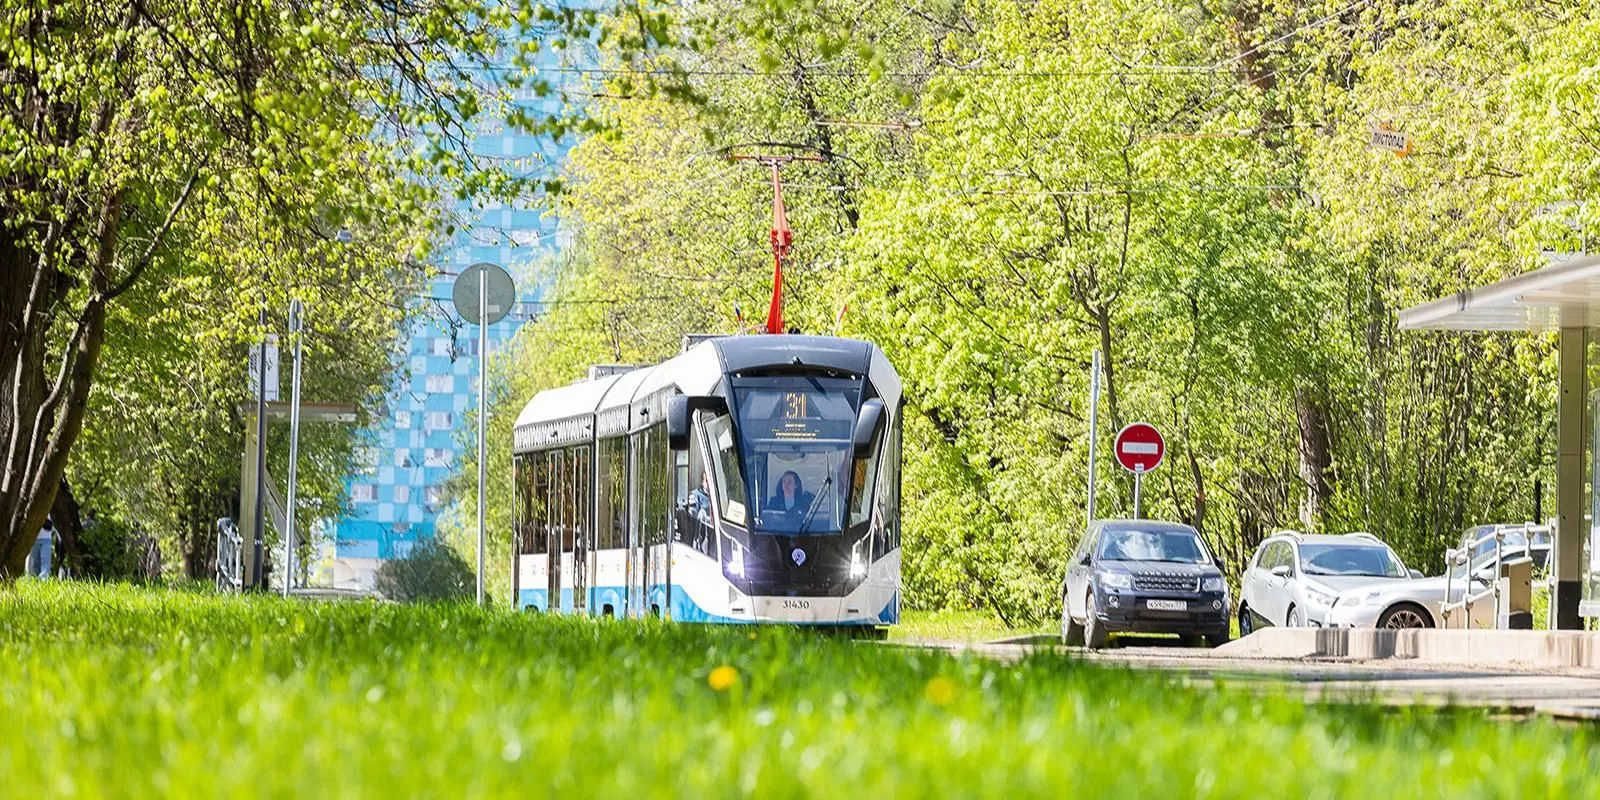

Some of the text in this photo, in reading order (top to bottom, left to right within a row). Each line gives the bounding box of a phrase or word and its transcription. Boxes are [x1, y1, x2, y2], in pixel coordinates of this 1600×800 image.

[1372, 131, 1405, 150] ЛИСТОПАД
[786, 393, 807, 418] 31
[783, 599, 810, 609] 31430
